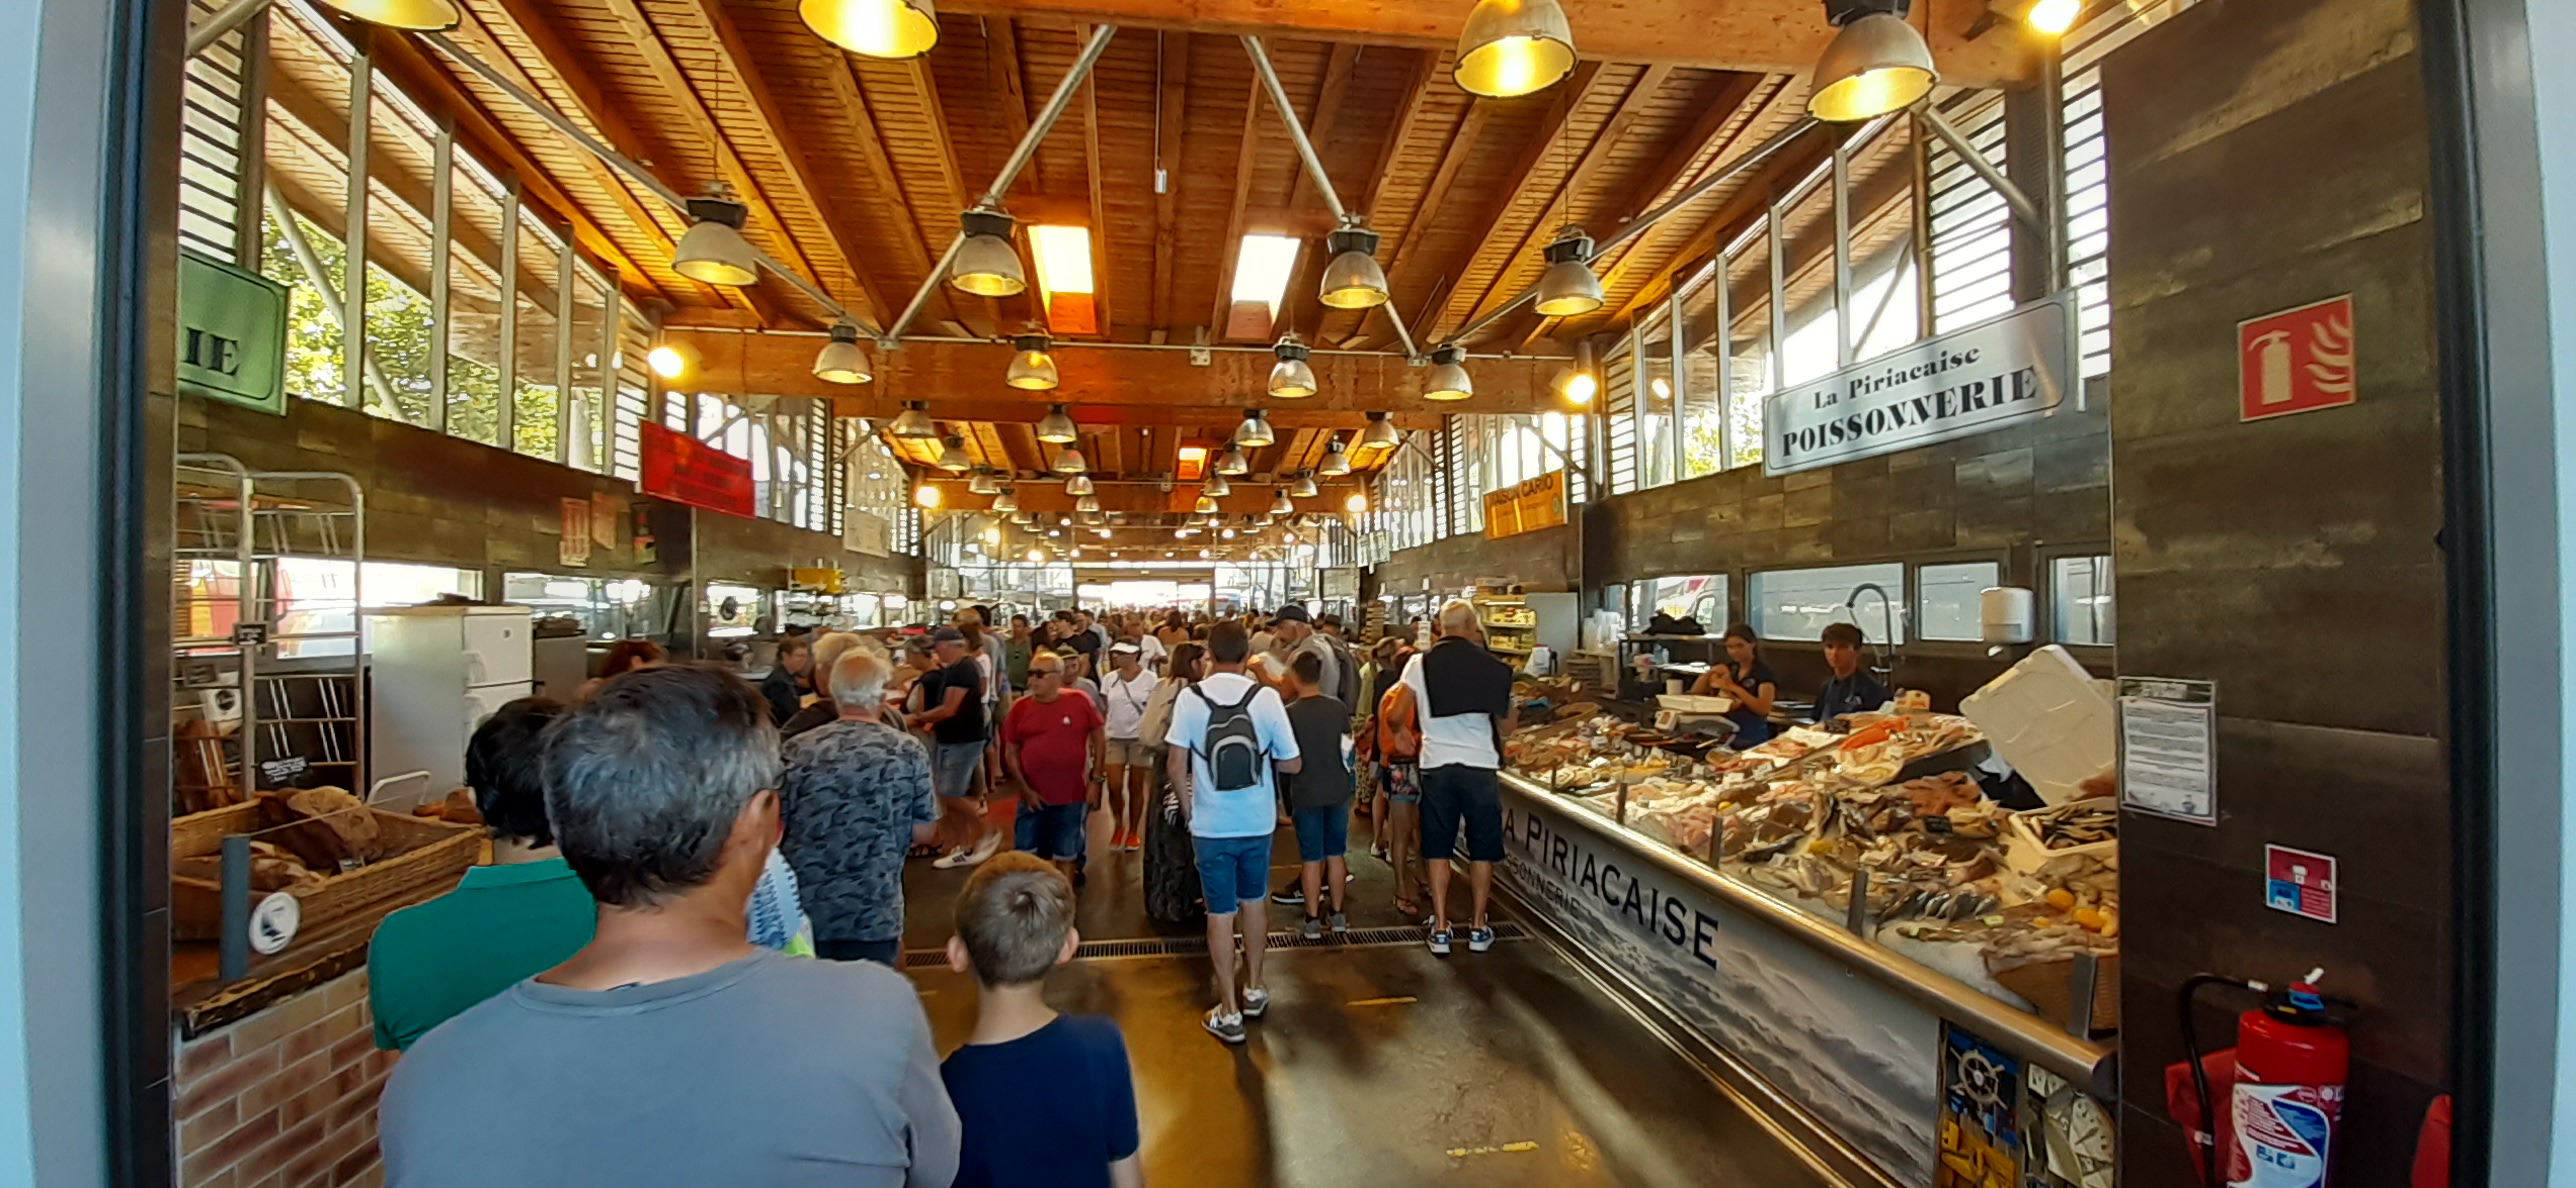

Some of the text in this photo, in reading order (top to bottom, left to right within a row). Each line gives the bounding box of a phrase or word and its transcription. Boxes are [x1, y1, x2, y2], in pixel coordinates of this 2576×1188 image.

[181, 326, 240, 376] IE
[1814, 346, 1981, 410] La Piriacaise
[1782, 365, 2037, 457] POISSONNERIE
[1525, 812, 1719, 971] PIRIACAISE
